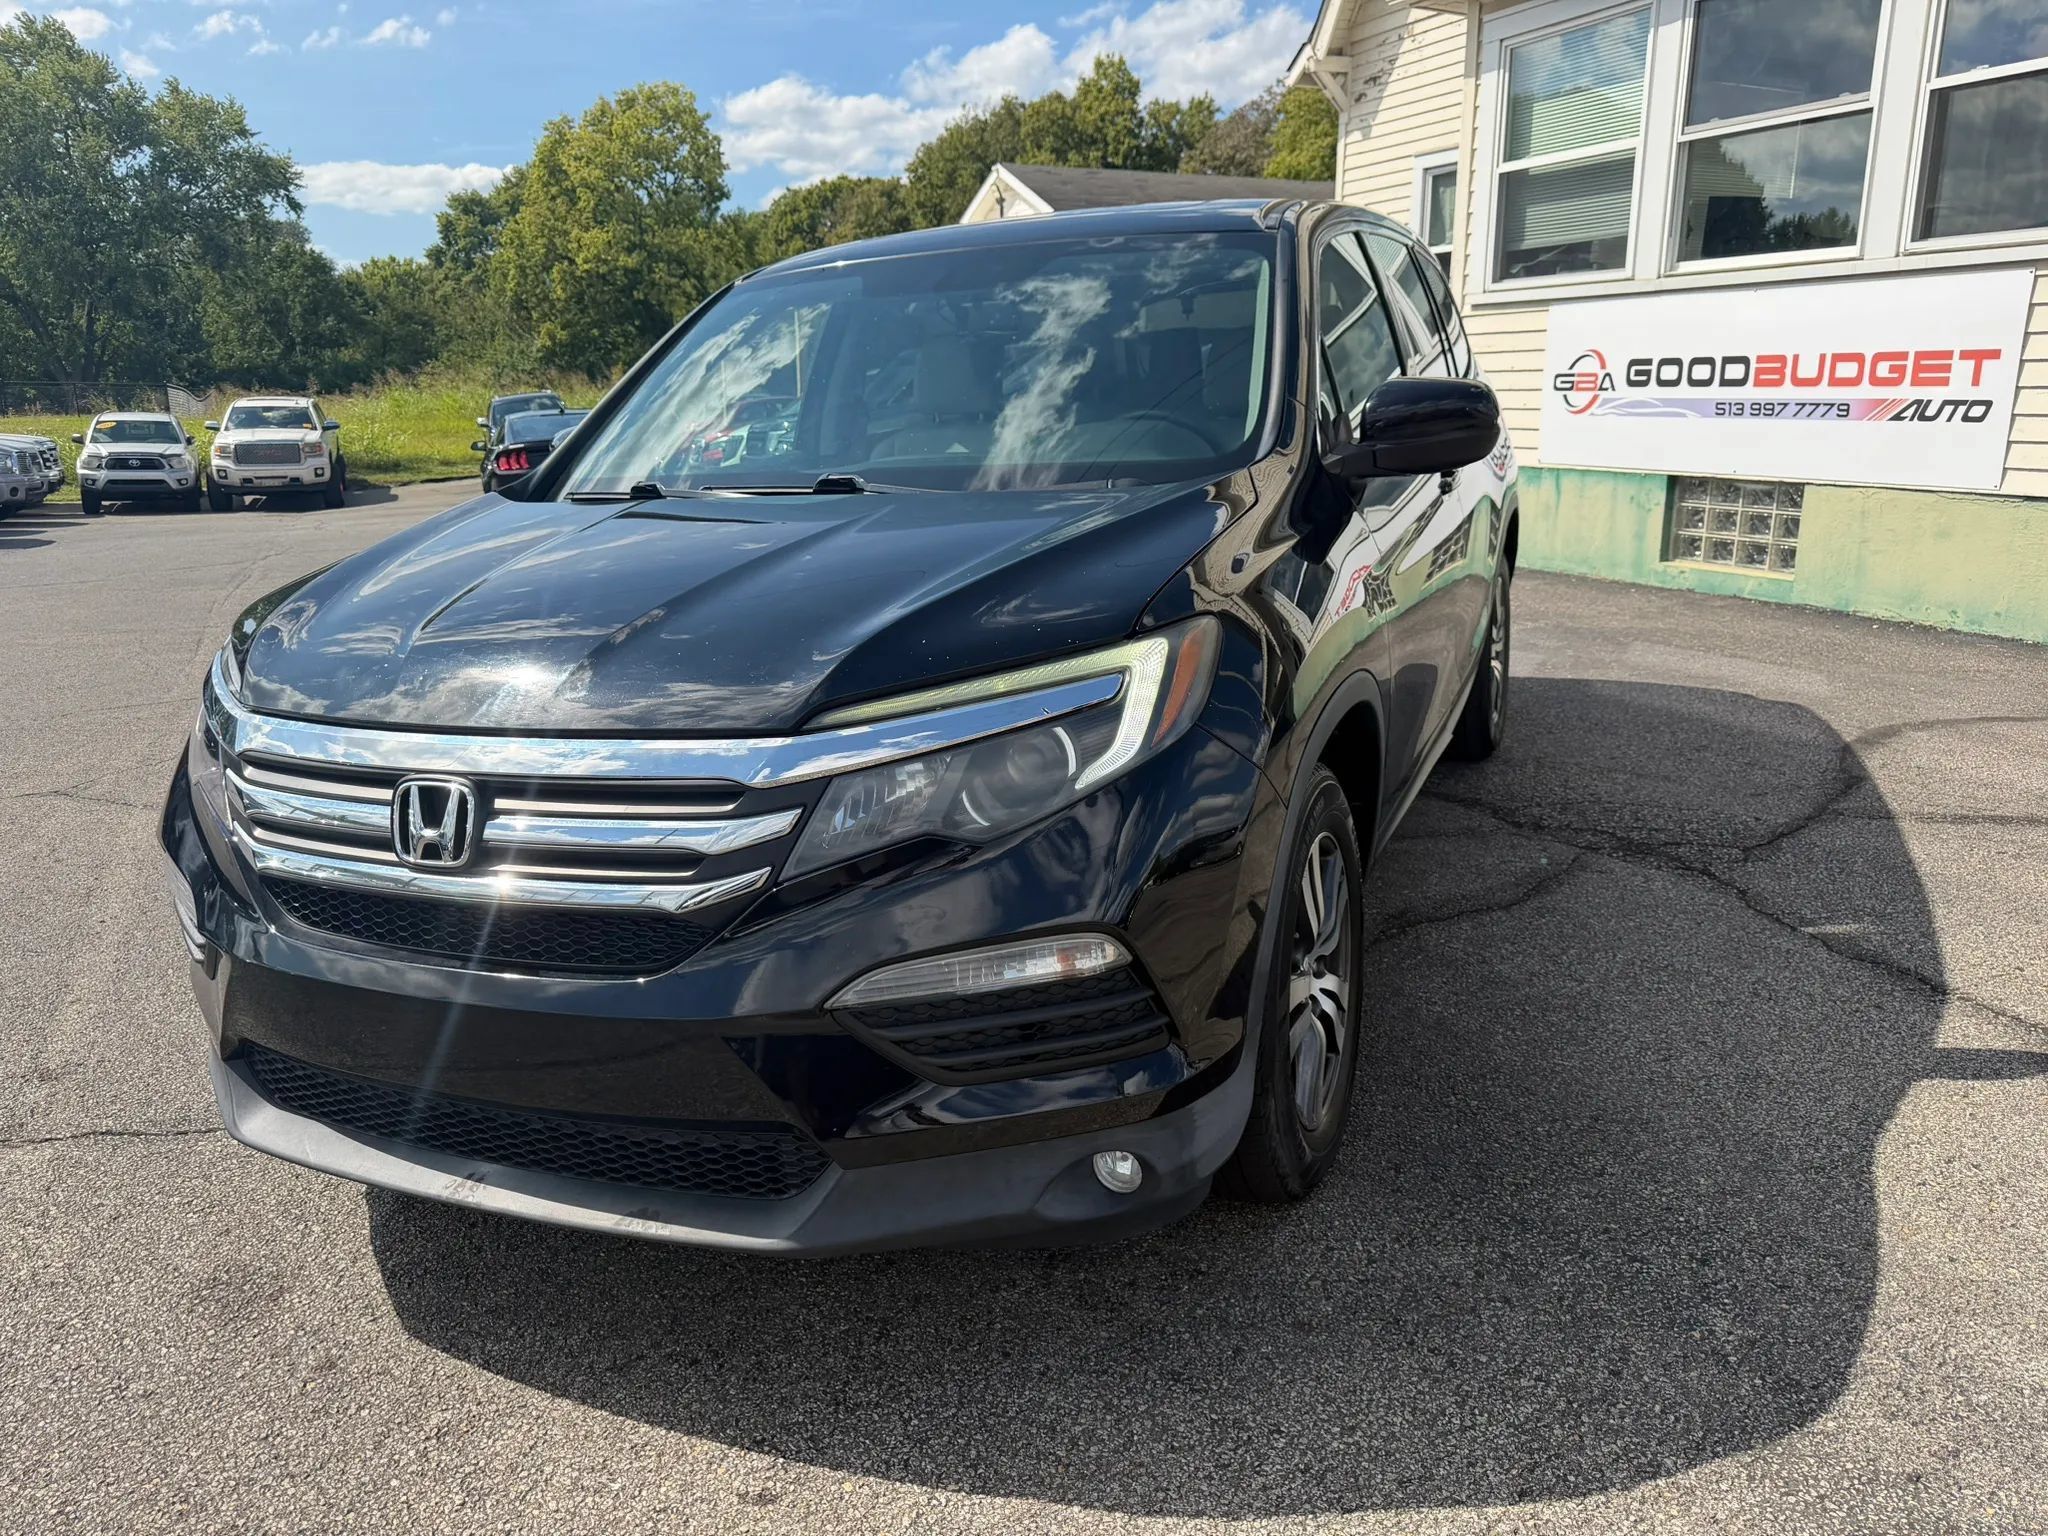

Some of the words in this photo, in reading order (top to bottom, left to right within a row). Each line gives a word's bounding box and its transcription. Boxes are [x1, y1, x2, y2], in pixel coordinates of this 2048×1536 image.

[1553, 372, 1616, 392] GBA
[1714, 402, 1745, 417] 513
[1749, 402, 1790, 417] 997
[1792, 402, 1851, 418] 7779
[1886, 398, 1994, 423] AUTO
